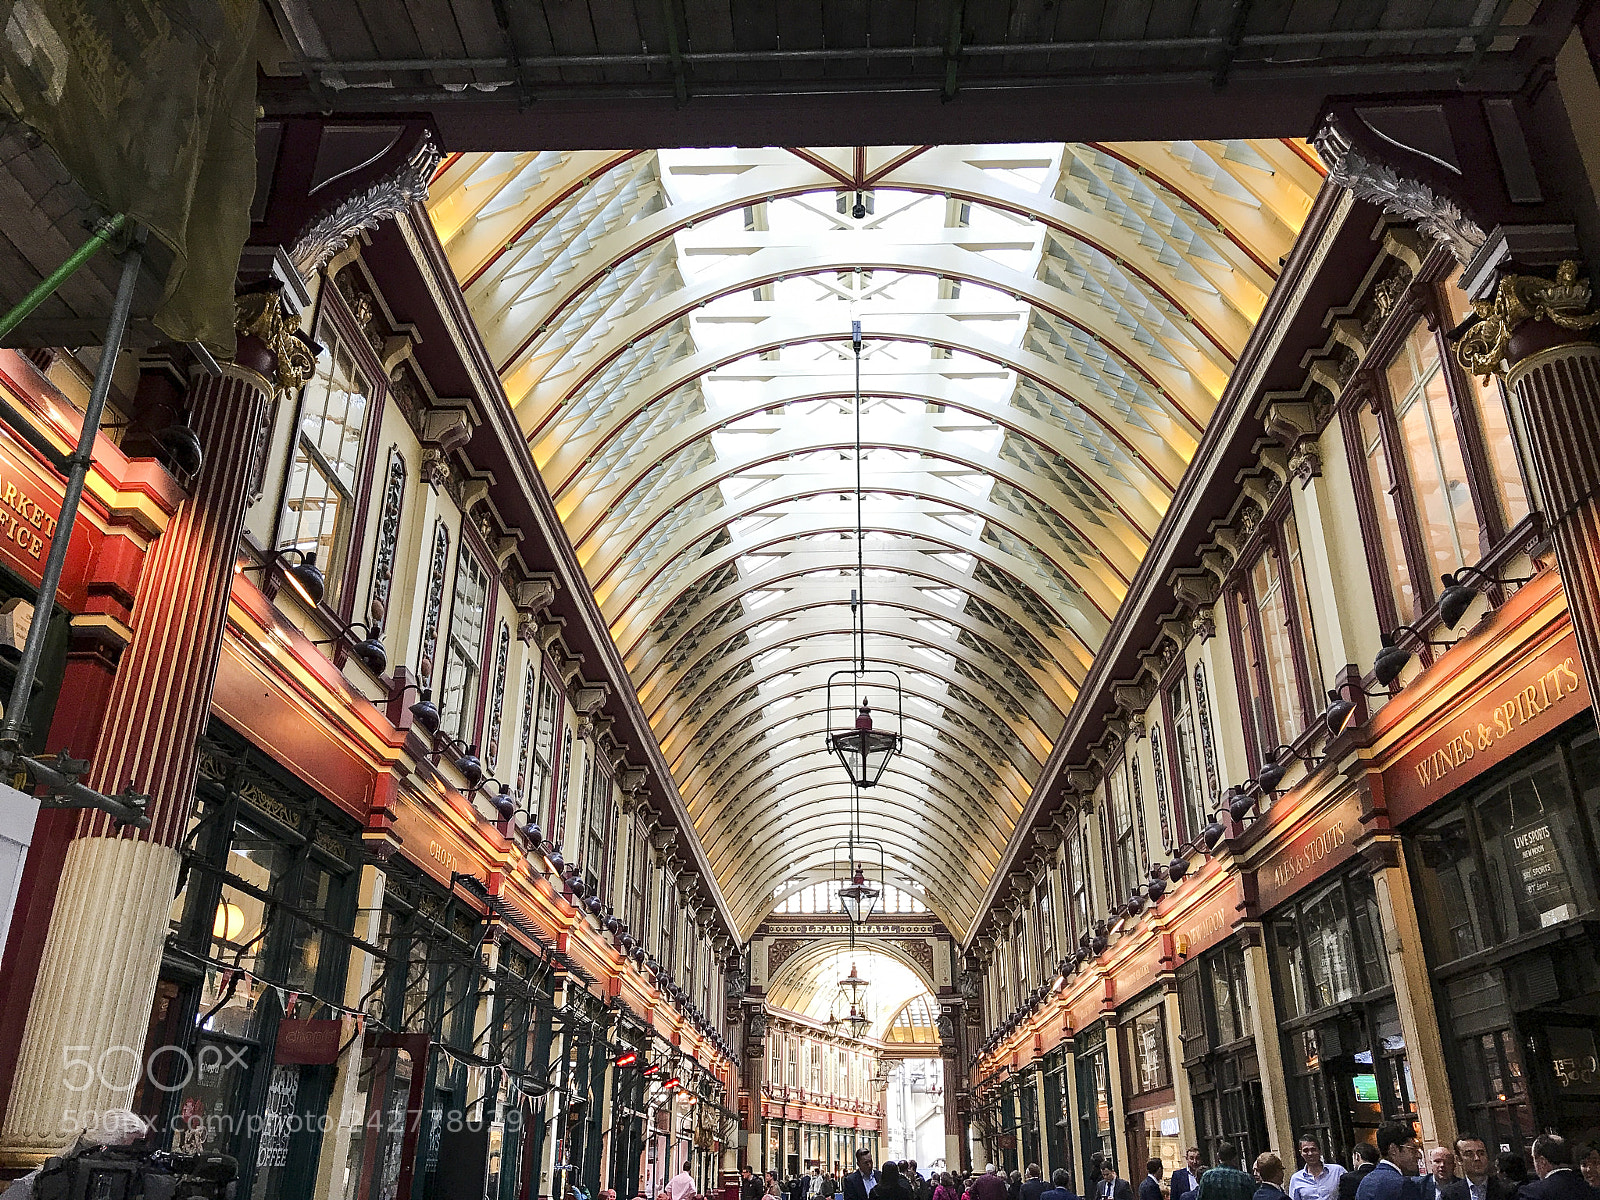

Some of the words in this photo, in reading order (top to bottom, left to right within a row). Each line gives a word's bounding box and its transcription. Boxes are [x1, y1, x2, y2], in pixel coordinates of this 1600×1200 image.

[1414, 729, 1475, 788] WINES
[1477, 722, 1493, 751] &
[1493, 657, 1579, 740] SPIRITS
[1274, 856, 1296, 889] ALES
[1304, 820, 1345, 868] STOUTS
[1513, 836, 1529, 849] LIVE
[1528, 826, 1550, 844] SPORTS
[1201, 907, 1225, 940] MOON
